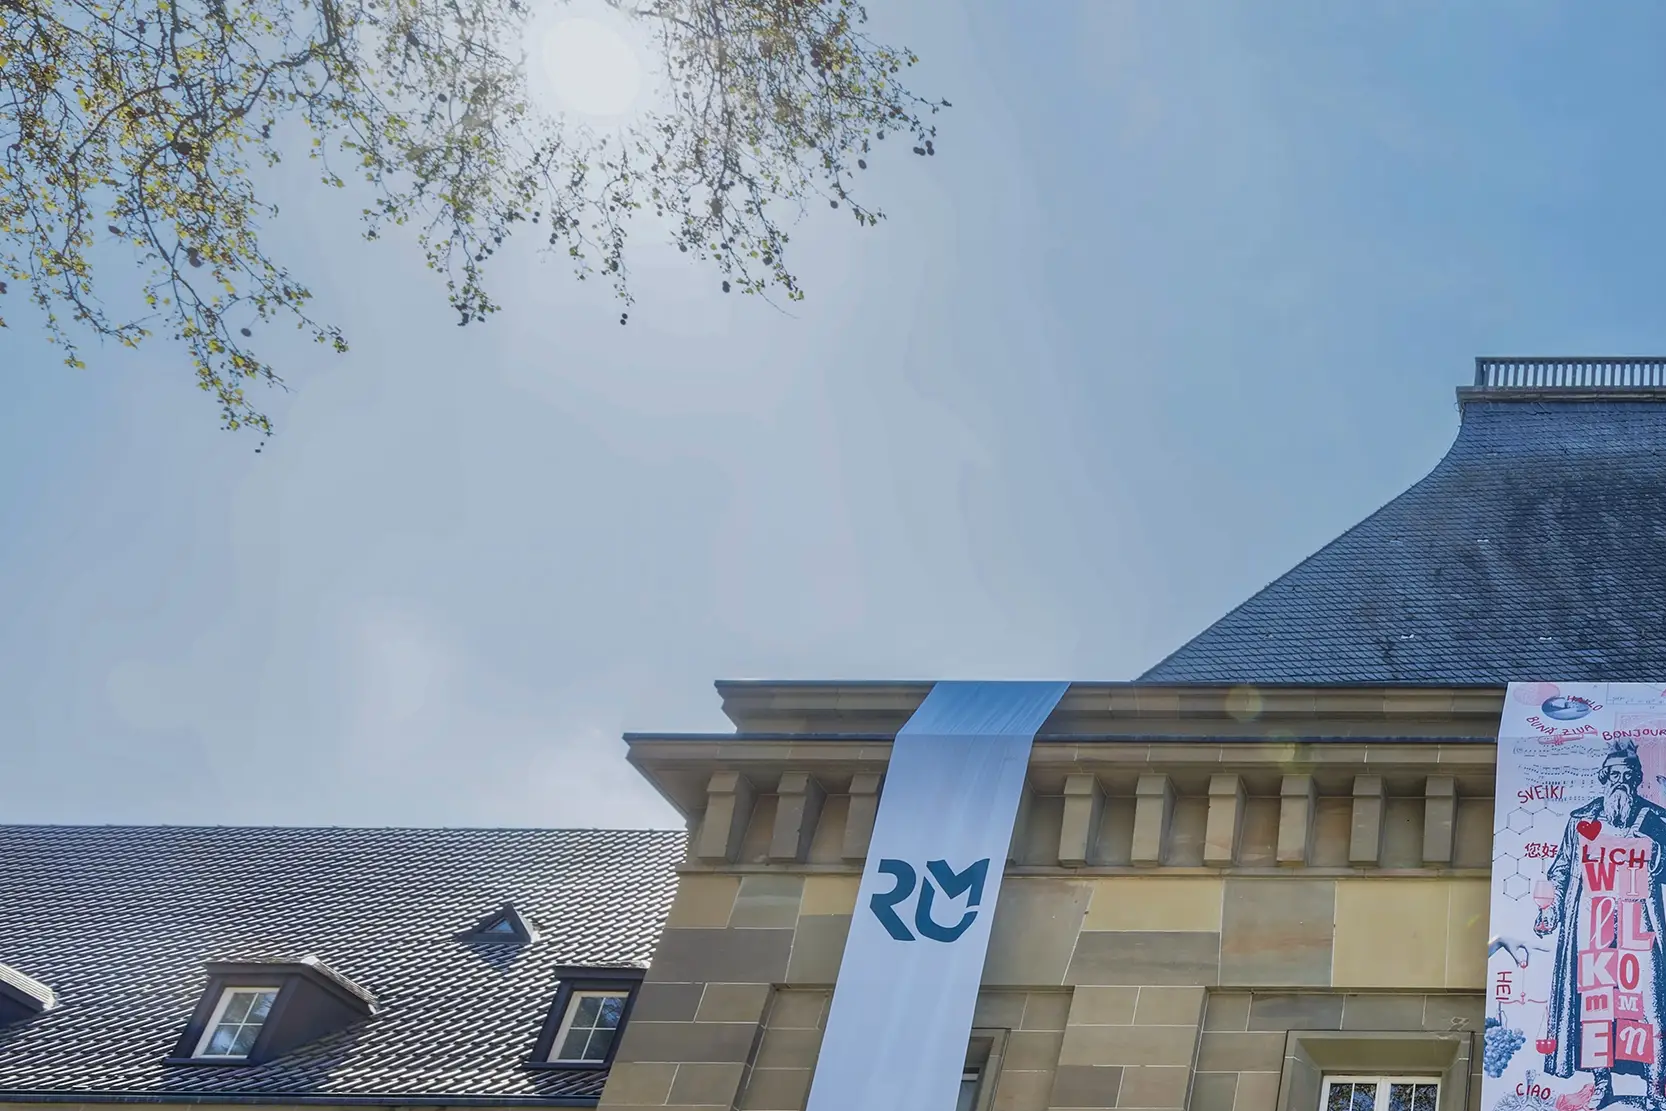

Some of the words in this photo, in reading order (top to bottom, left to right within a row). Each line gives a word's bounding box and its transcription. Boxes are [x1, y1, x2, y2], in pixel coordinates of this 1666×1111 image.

[1517, 785, 1565, 803] SVEIKI
[1524, 842, 1558, 858] 您好
[1582, 843, 1645, 869] LICH
[1496, 971, 1512, 1001] HEI
[1516, 1083, 1551, 1100] CIAO
